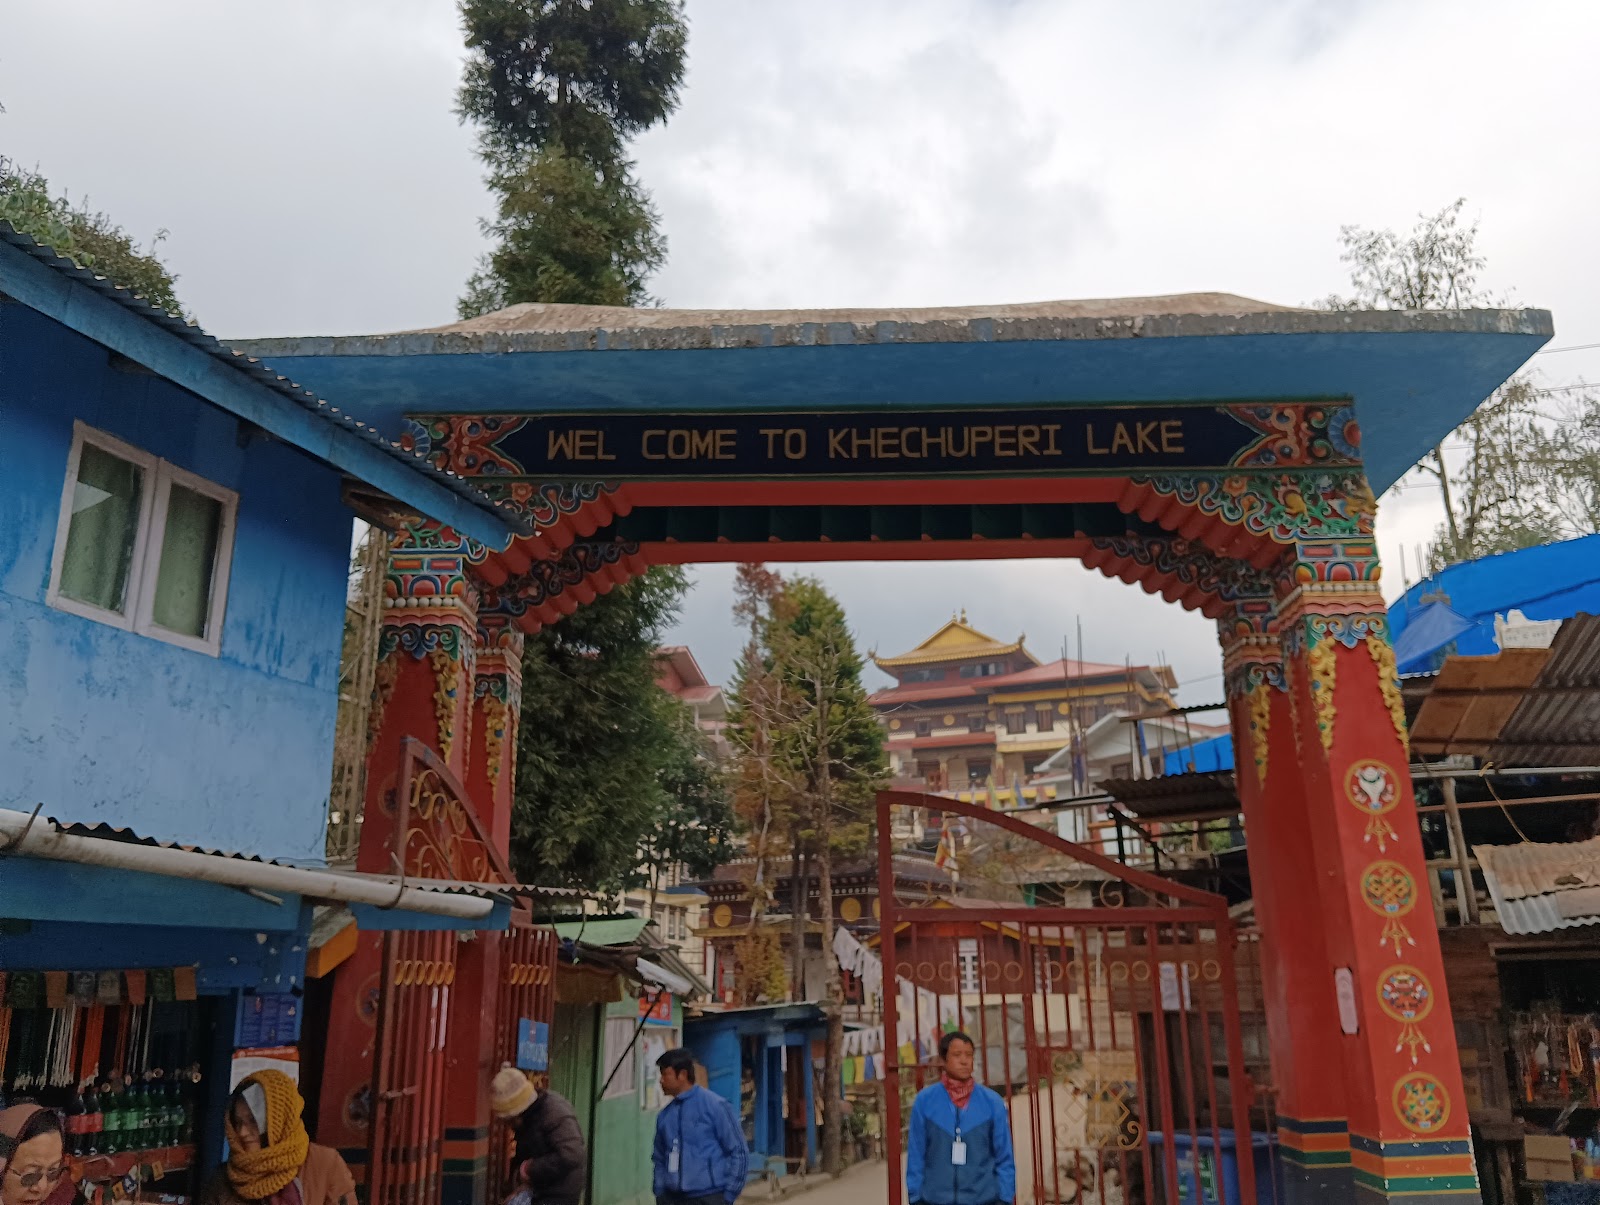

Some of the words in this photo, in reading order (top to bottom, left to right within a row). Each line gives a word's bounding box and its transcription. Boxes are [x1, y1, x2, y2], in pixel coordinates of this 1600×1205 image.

[548, 430, 616, 460] WEL
[643, 430, 737, 459] COME
[760, 429, 806, 459] TO
[828, 425, 1062, 458] KHECHUPERI
[1087, 421, 1184, 454] LAKE
